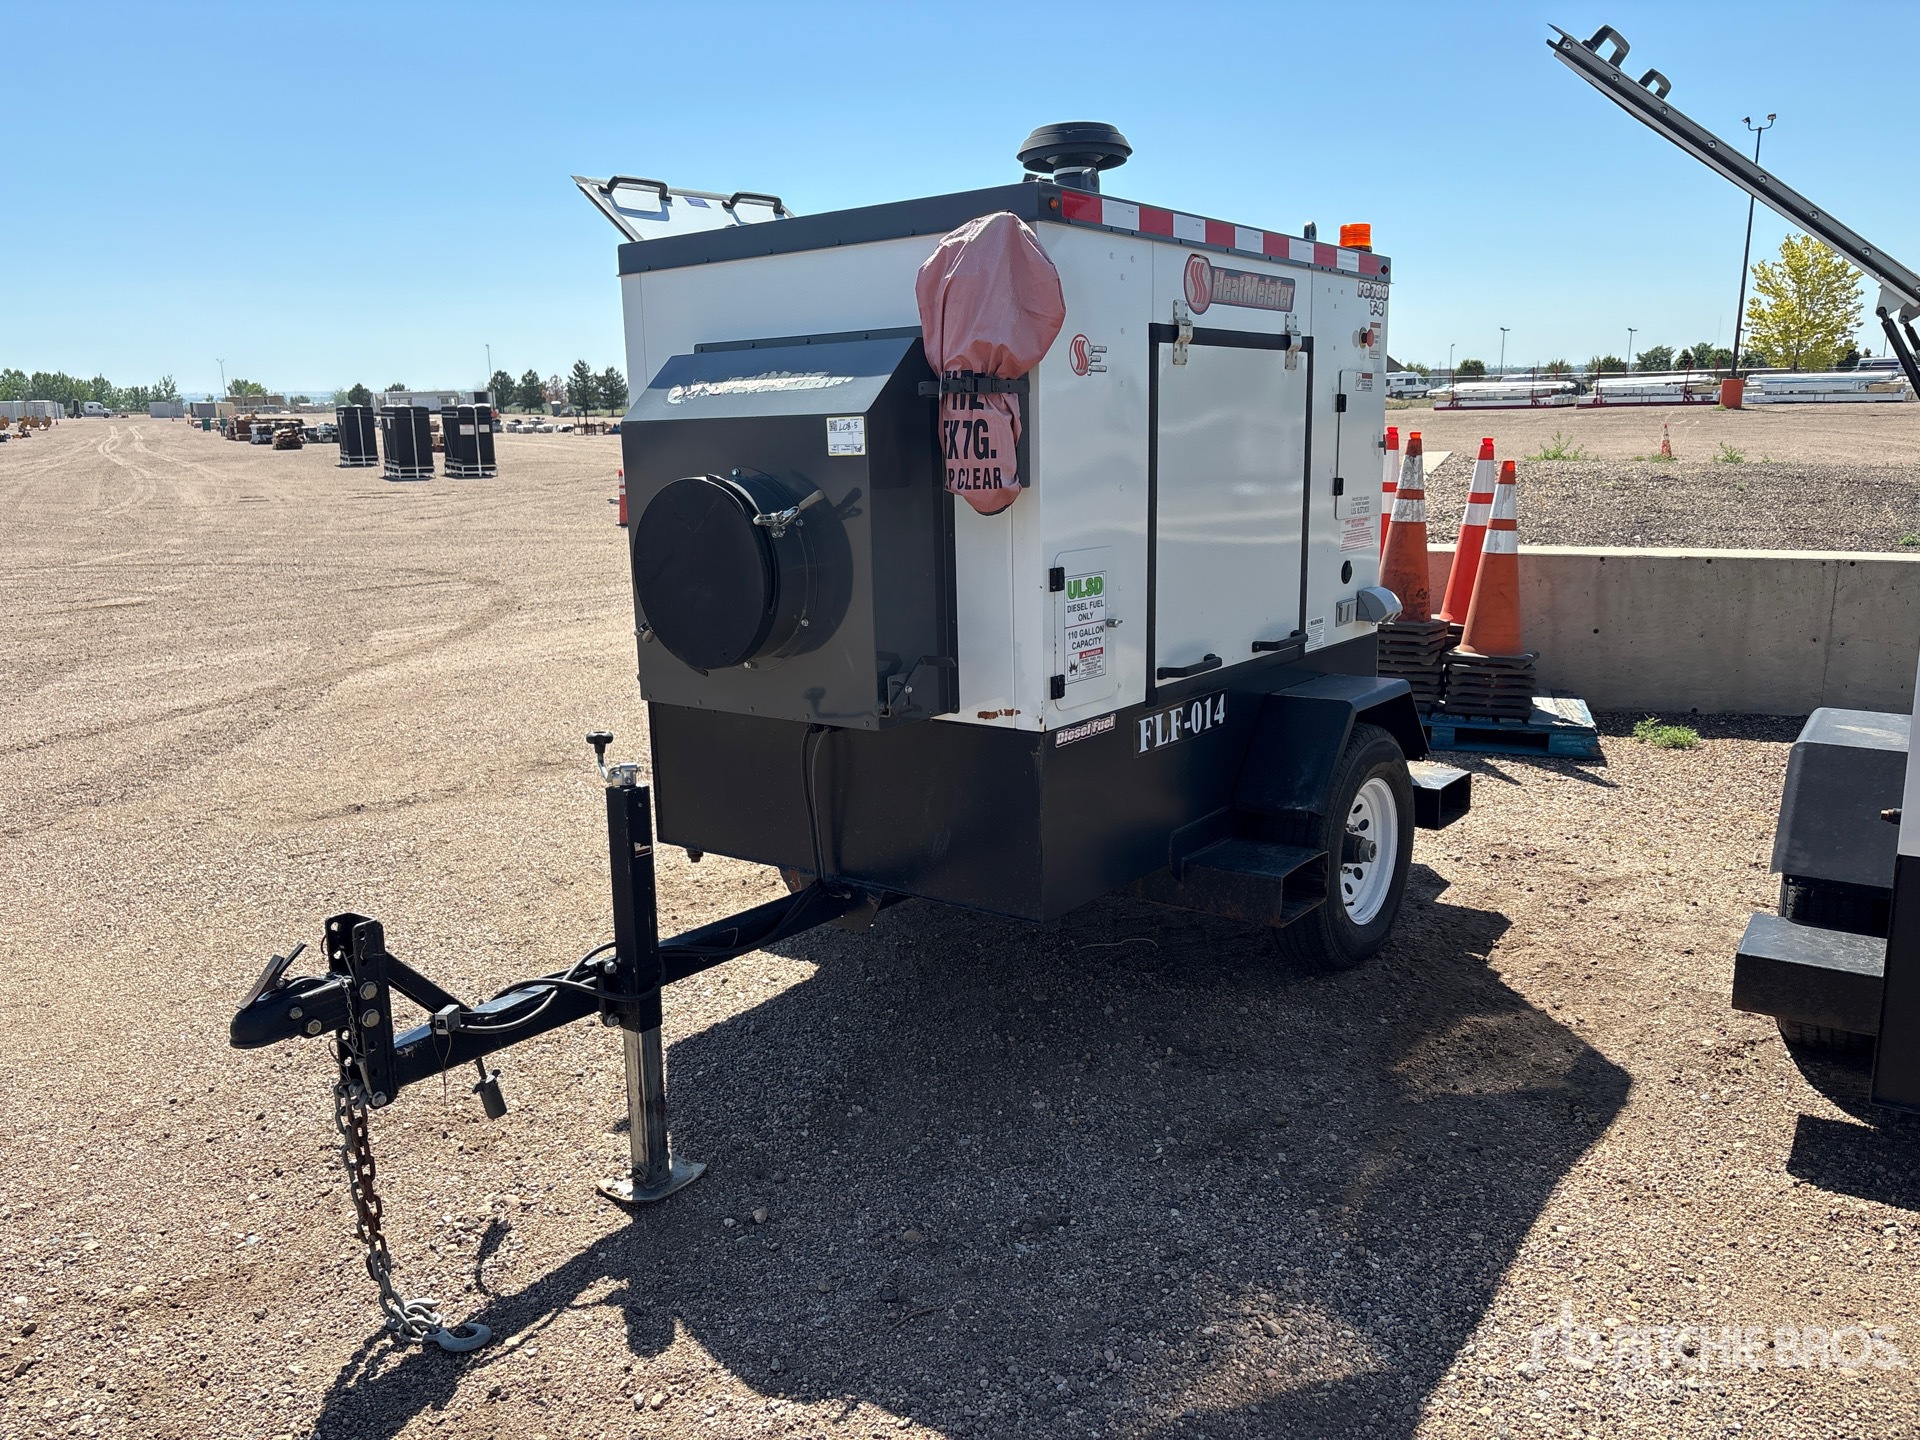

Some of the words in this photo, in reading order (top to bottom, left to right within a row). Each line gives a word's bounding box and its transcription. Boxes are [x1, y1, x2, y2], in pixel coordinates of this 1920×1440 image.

[1213, 268, 1294, 308] HeatMeister
[957, 467, 1003, 490] CLEAR
[1067, 576, 1103, 600] ULSD
[1067, 604, 1088, 613] DIESEL
[1089, 600, 1104, 609] FUEL
[1078, 612, 1094, 622] ONLY
[1068, 630, 1077, 640] 110
[1079, 625, 1104, 638] GALLON
[1071, 637, 1102, 651] CAPACITY
[1085, 649, 1102, 657] DANGER
[1056, 721, 1092, 747] Diesel
[1092, 714, 1116, 736] Fuel
[1138, 693, 1226, 754] FLF-014
